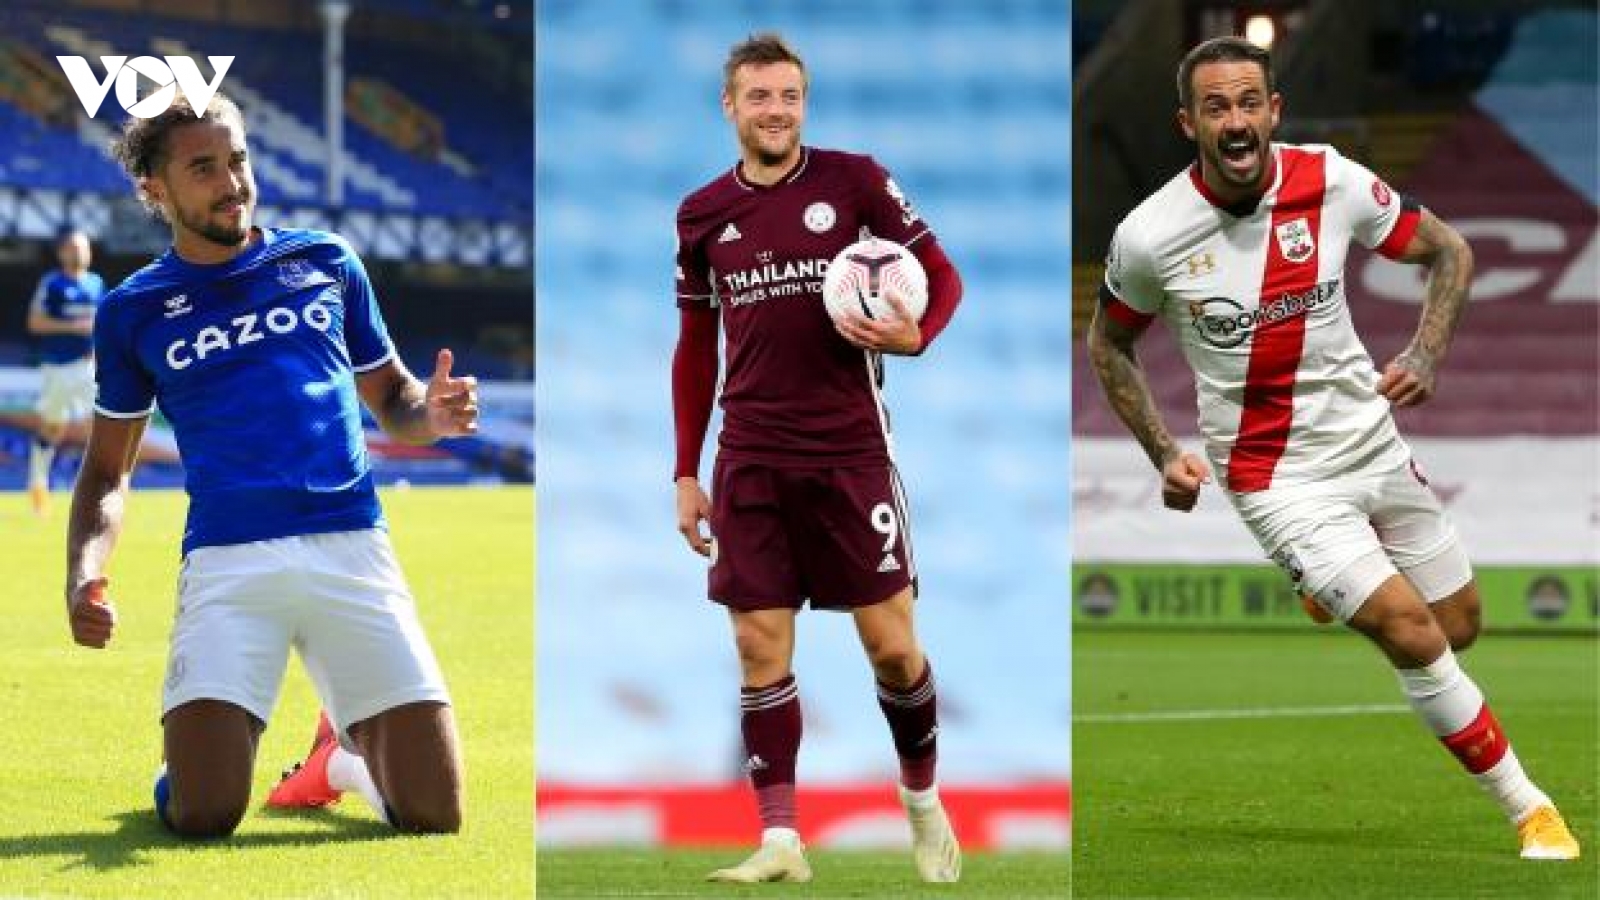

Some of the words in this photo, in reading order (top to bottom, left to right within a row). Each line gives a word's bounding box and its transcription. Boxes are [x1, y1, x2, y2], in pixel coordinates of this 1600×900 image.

[723, 259, 829, 290] THAILAND
[805, 281, 825, 293] YO
[166, 302, 332, 370] CAZOO
[872, 502, 898, 552] 9
